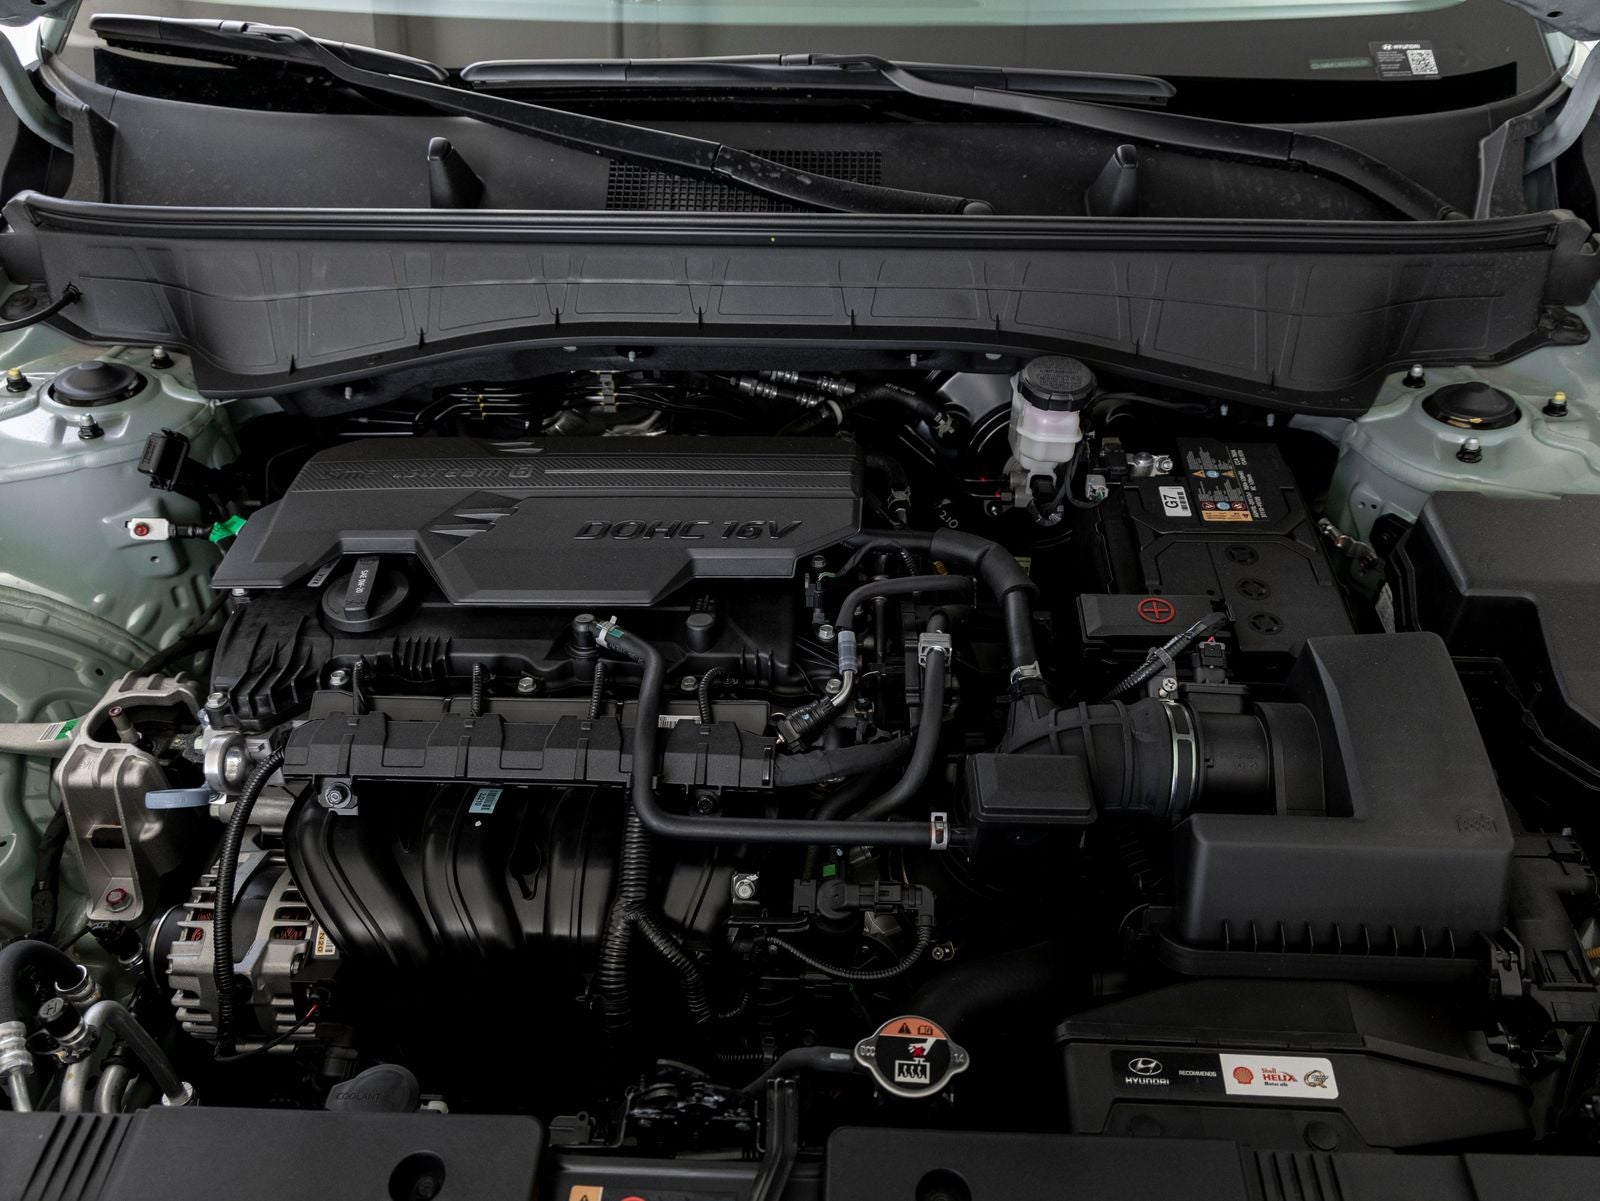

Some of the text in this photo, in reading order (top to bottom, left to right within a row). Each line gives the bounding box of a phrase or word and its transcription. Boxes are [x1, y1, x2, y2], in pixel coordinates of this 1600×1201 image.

[1162, 494, 1179, 509] G7
[573, 519, 803, 541] DOHC 16V
[1178, 1069, 1217, 1078] RECOMMENDS
[1263, 1073, 1297, 1083] HELIX
[1125, 1077, 1170, 1086] HYUNDAI
